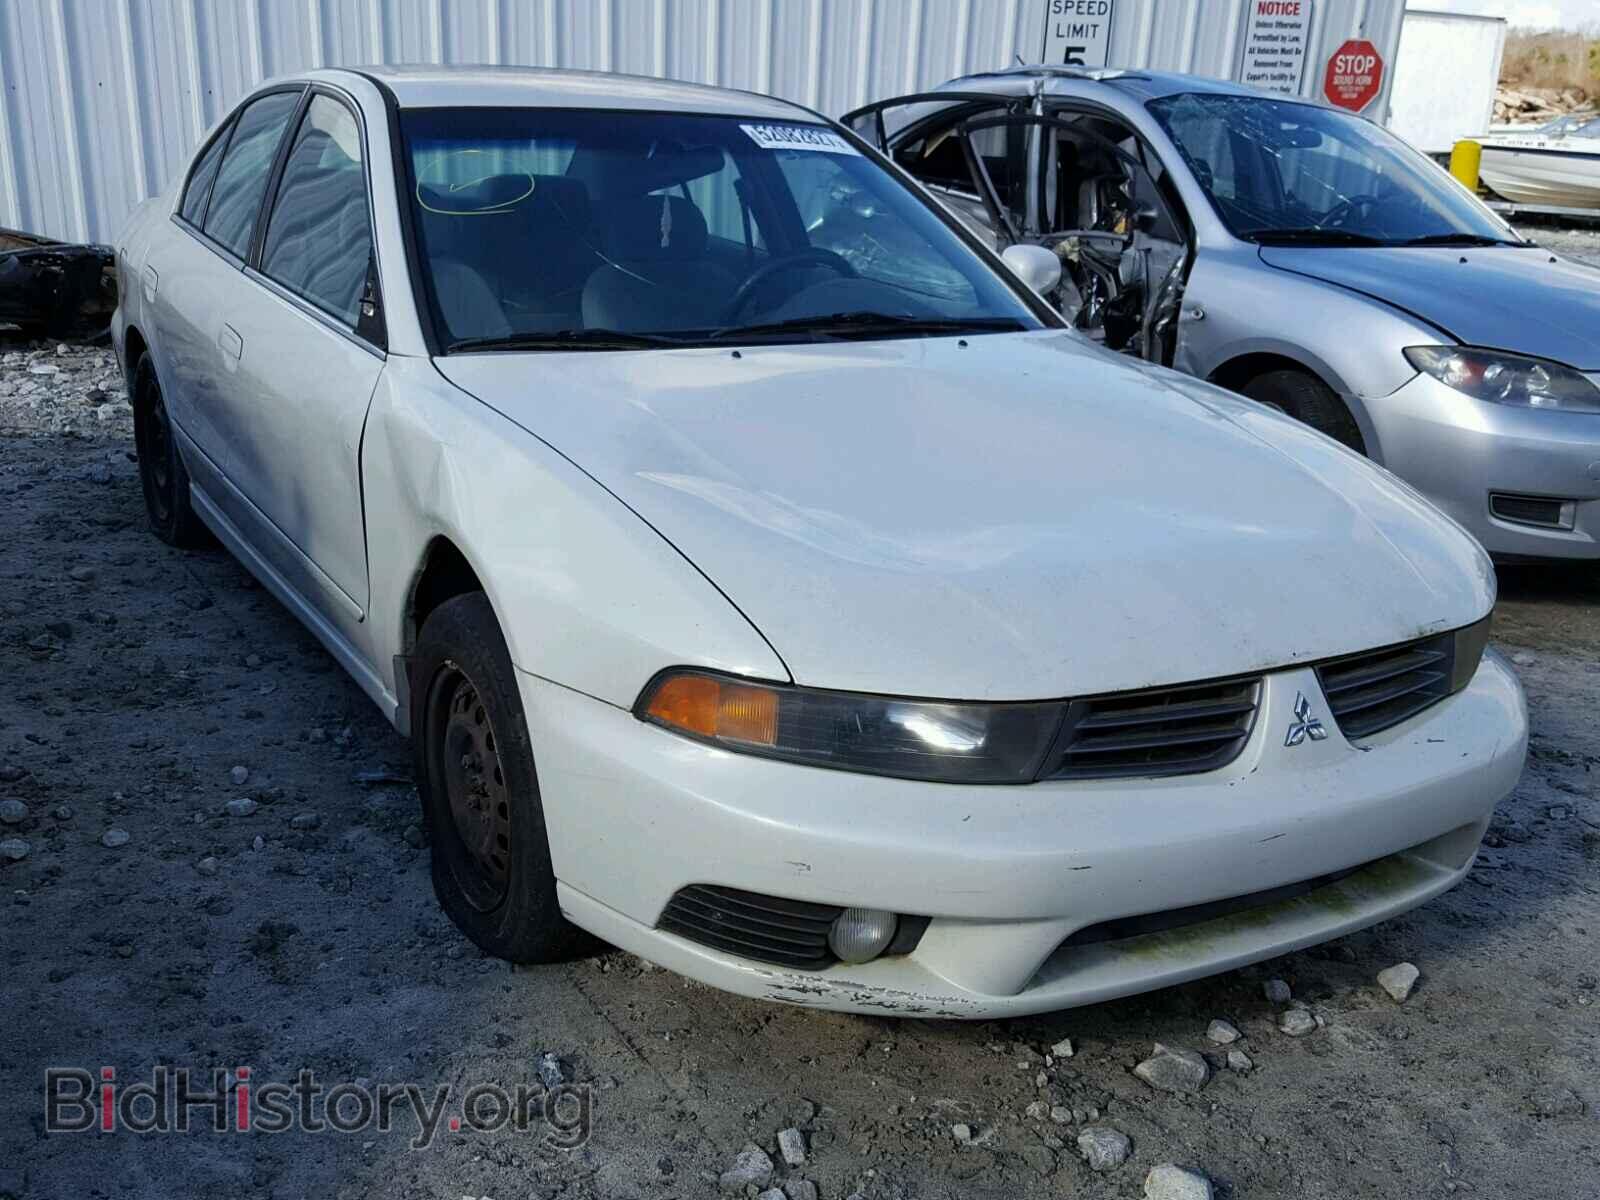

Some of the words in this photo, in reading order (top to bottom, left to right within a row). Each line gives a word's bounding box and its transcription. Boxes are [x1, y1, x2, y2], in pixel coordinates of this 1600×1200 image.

[1052, 0, 1108, 15] SPEED
[1257, 1, 1301, 16] NOTICE
[1056, 23, 1100, 38] LIMIT
[1275, 20, 1302, 29] Otherwise
[1253, 34, 1279, 42] Permitted
[1280, 35, 1287, 43] by
[1064, 46, 1086, 66] 5
[1257, 47, 1278, 55] Vehicles
[1280, 47, 1293, 55] Must
[1335, 54, 1376, 74] STOP
